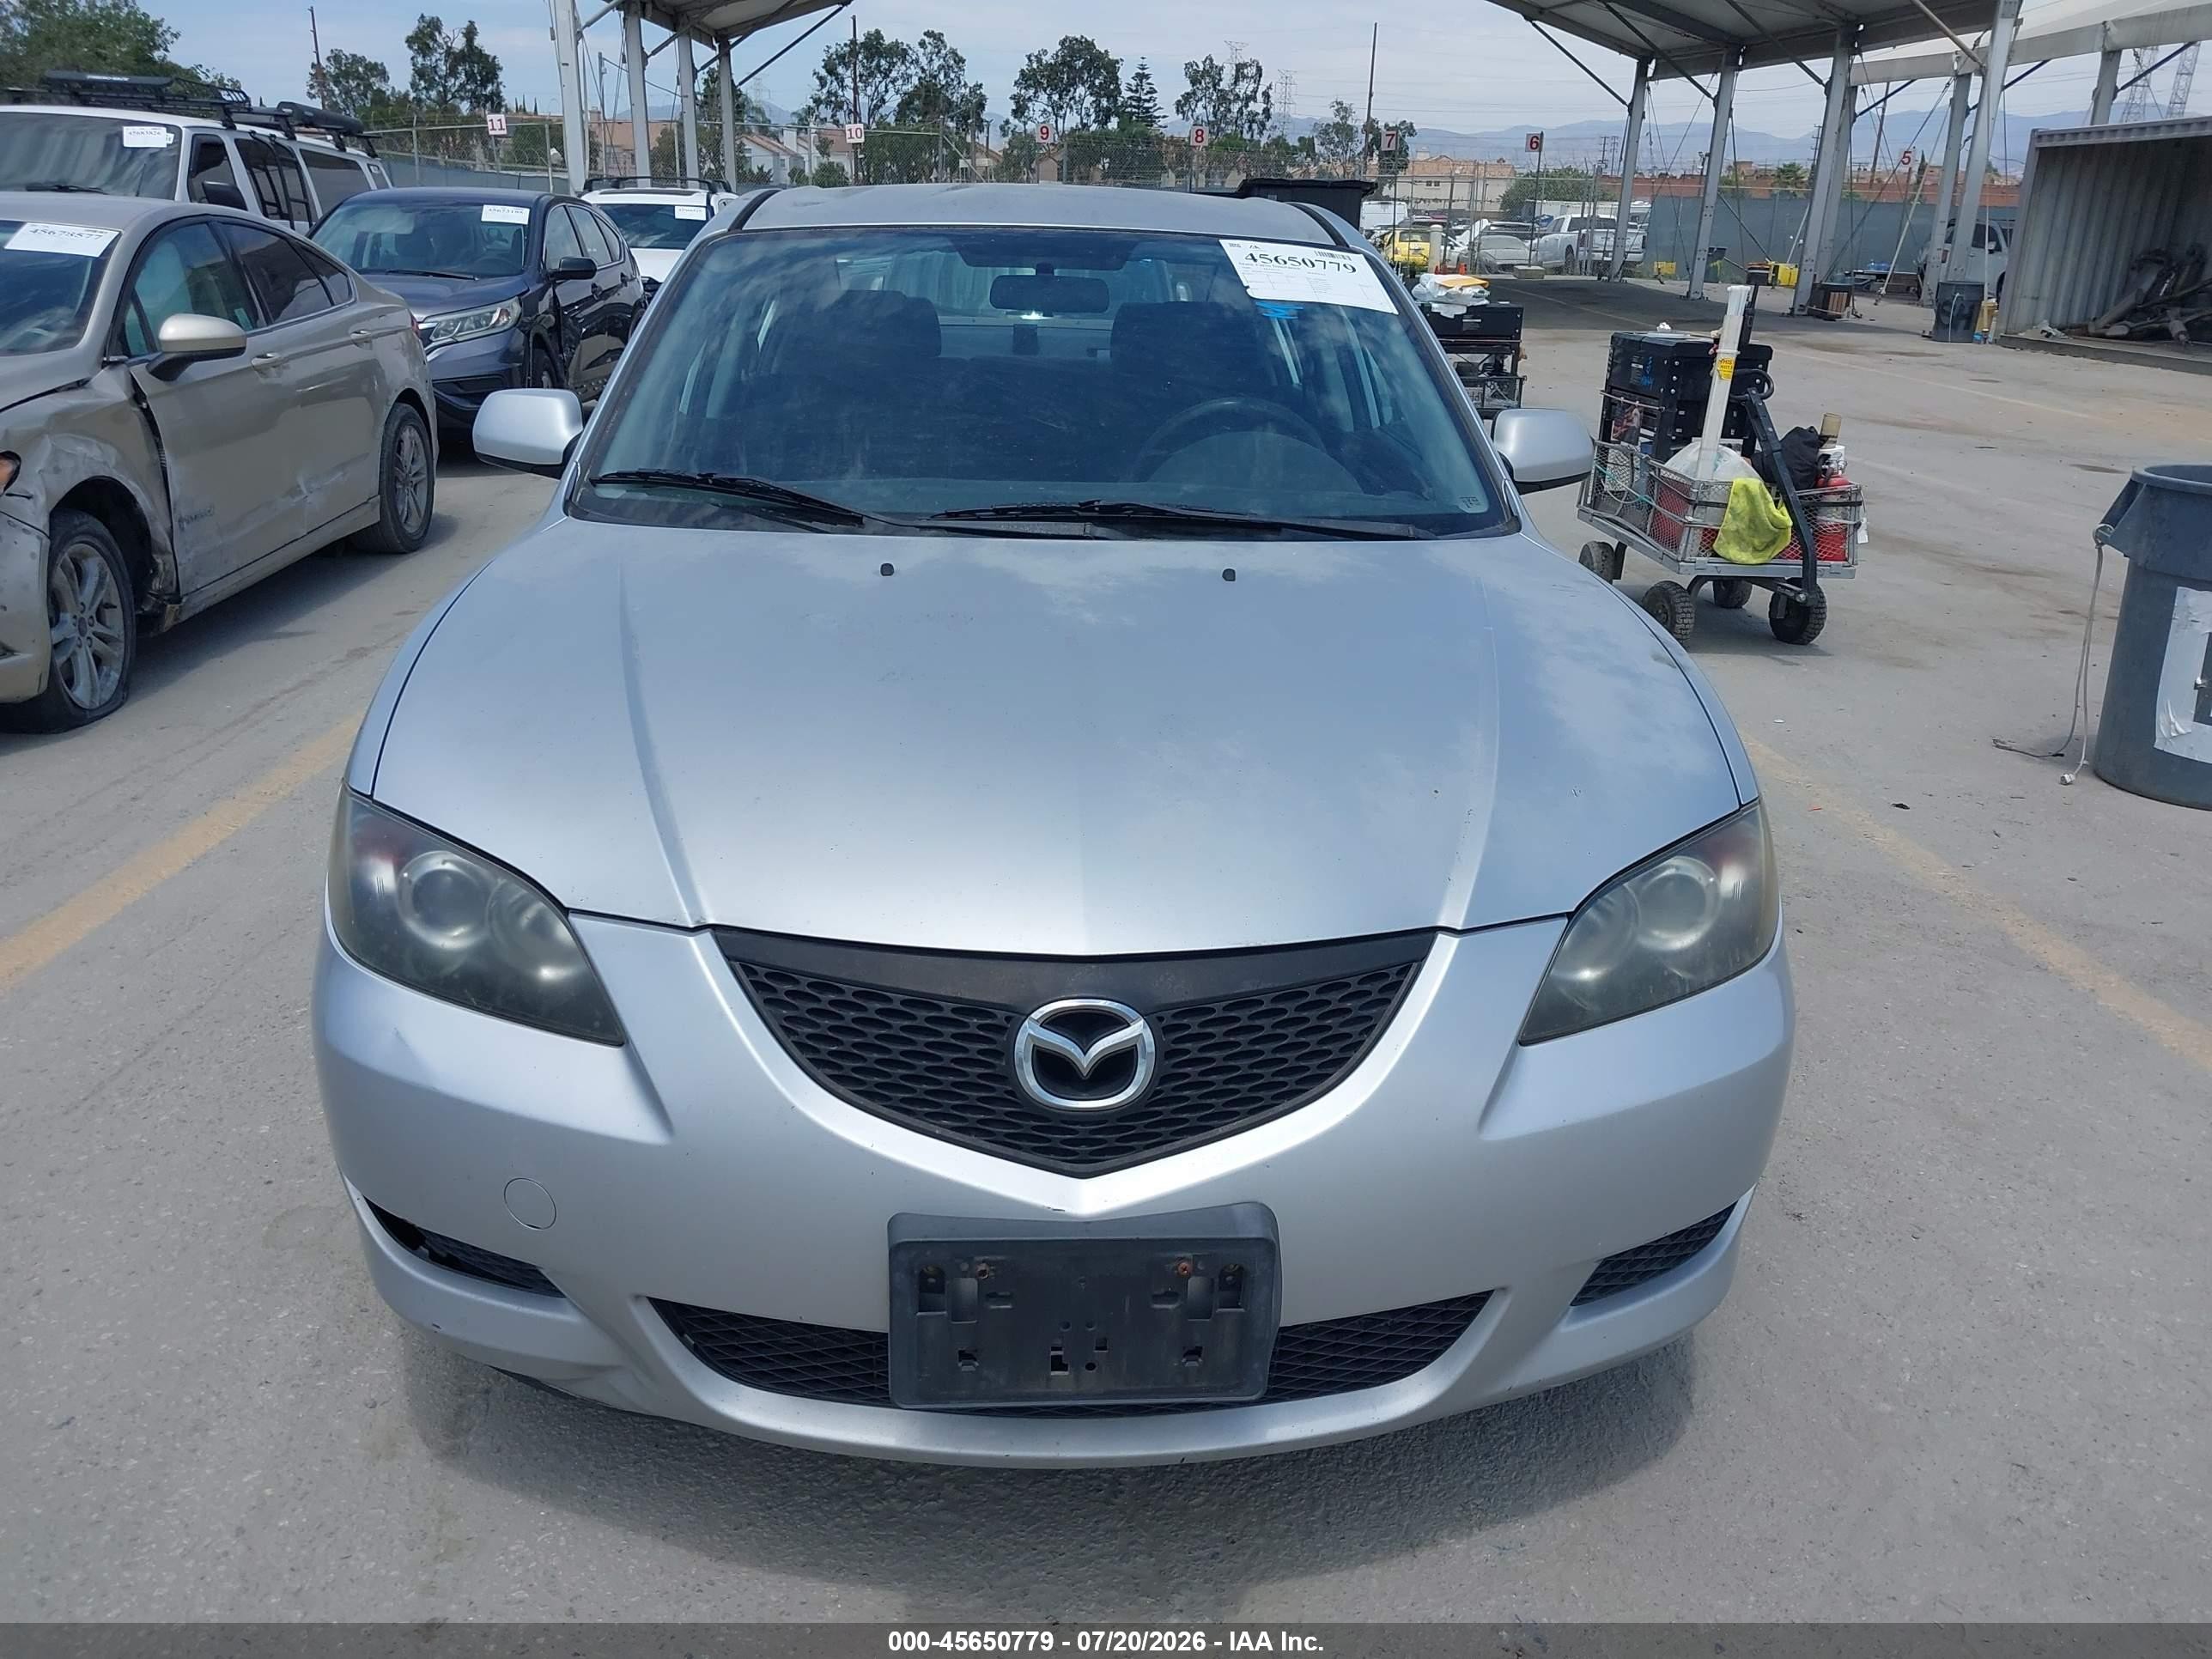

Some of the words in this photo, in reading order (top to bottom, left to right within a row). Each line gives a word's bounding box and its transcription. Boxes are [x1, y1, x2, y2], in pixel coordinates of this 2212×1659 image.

[489, 118, 505, 131] 11
[847, 127, 863, 139] 10
[1040, 125, 1049, 140] 9
[1194, 128, 1204, 143] 8
[1385, 133, 1395, 148] 7
[1529, 135, 1540, 150] 6
[1901, 150, 1912, 165] 5
[1244, 252, 1357, 274] 45650779
